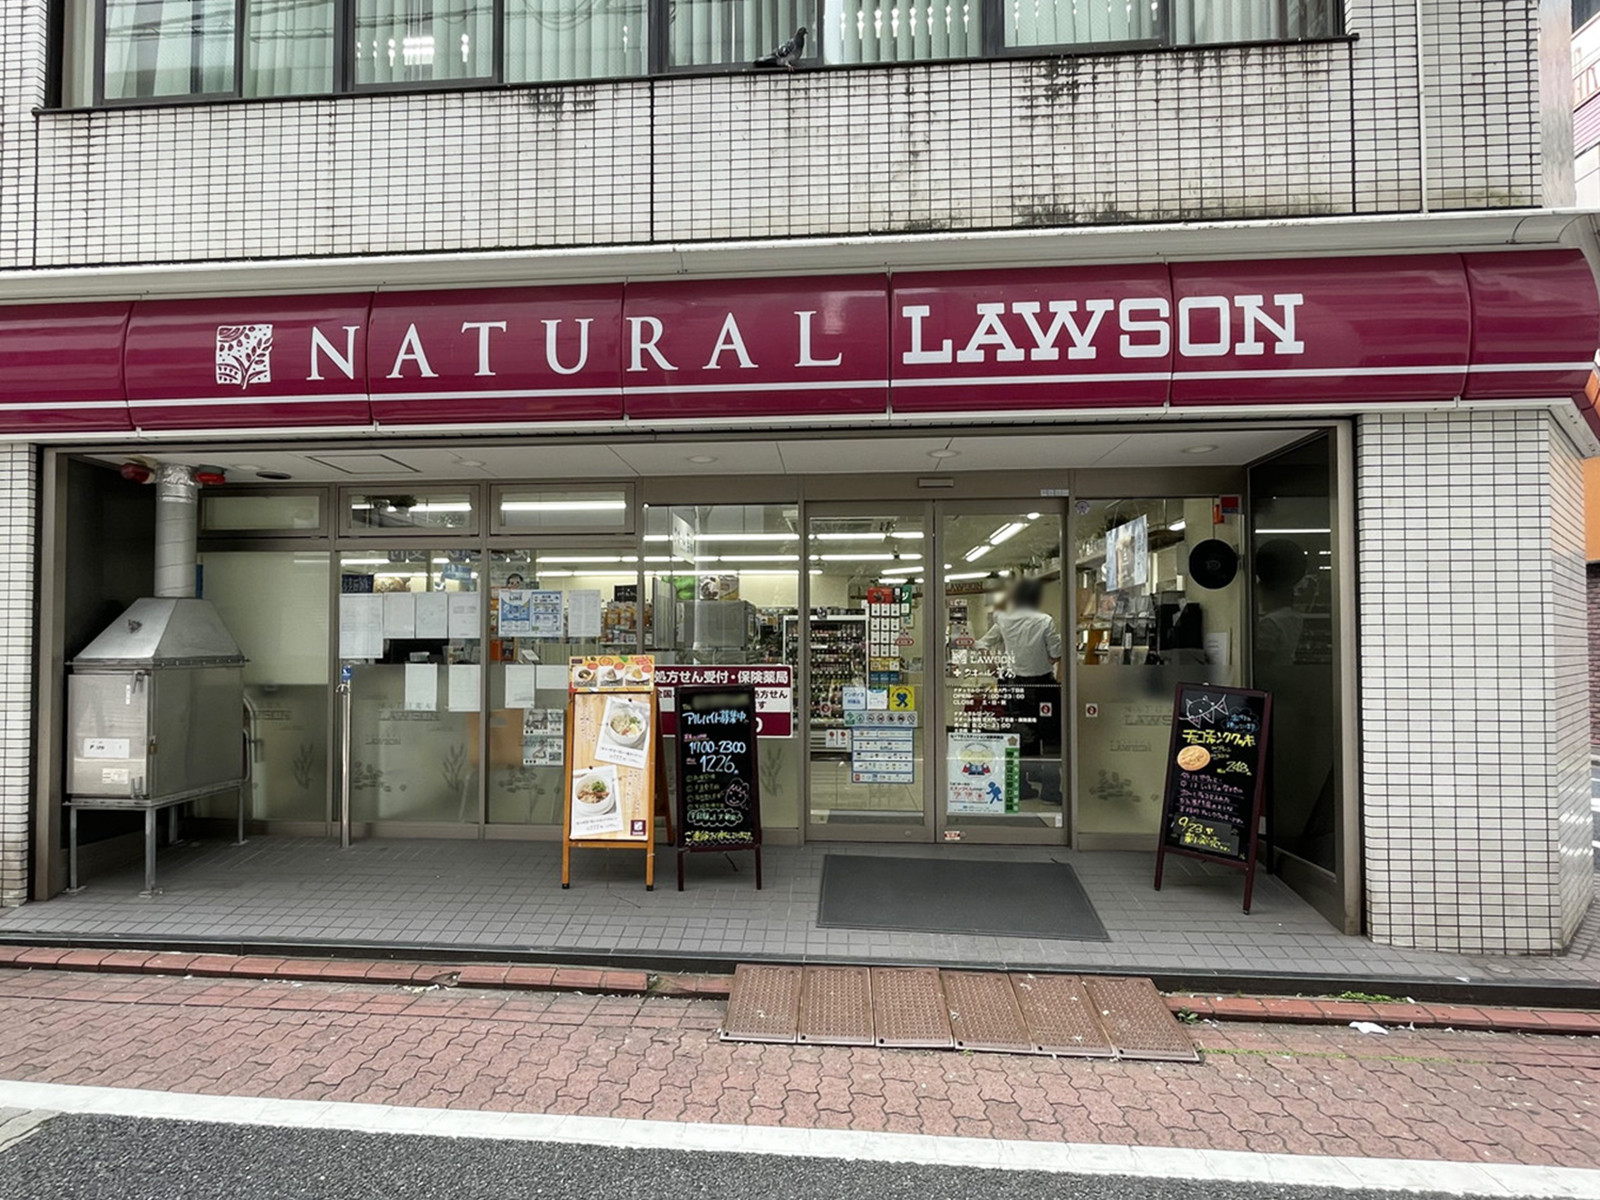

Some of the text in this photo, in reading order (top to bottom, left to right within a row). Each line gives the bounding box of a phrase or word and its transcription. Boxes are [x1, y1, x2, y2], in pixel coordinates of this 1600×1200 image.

[306, 293, 1305, 382] NATURAL LAWSON
[970, 655, 1016, 664] LAWSON
[654, 670, 788, 684] 処方せん受付・保険薬局
